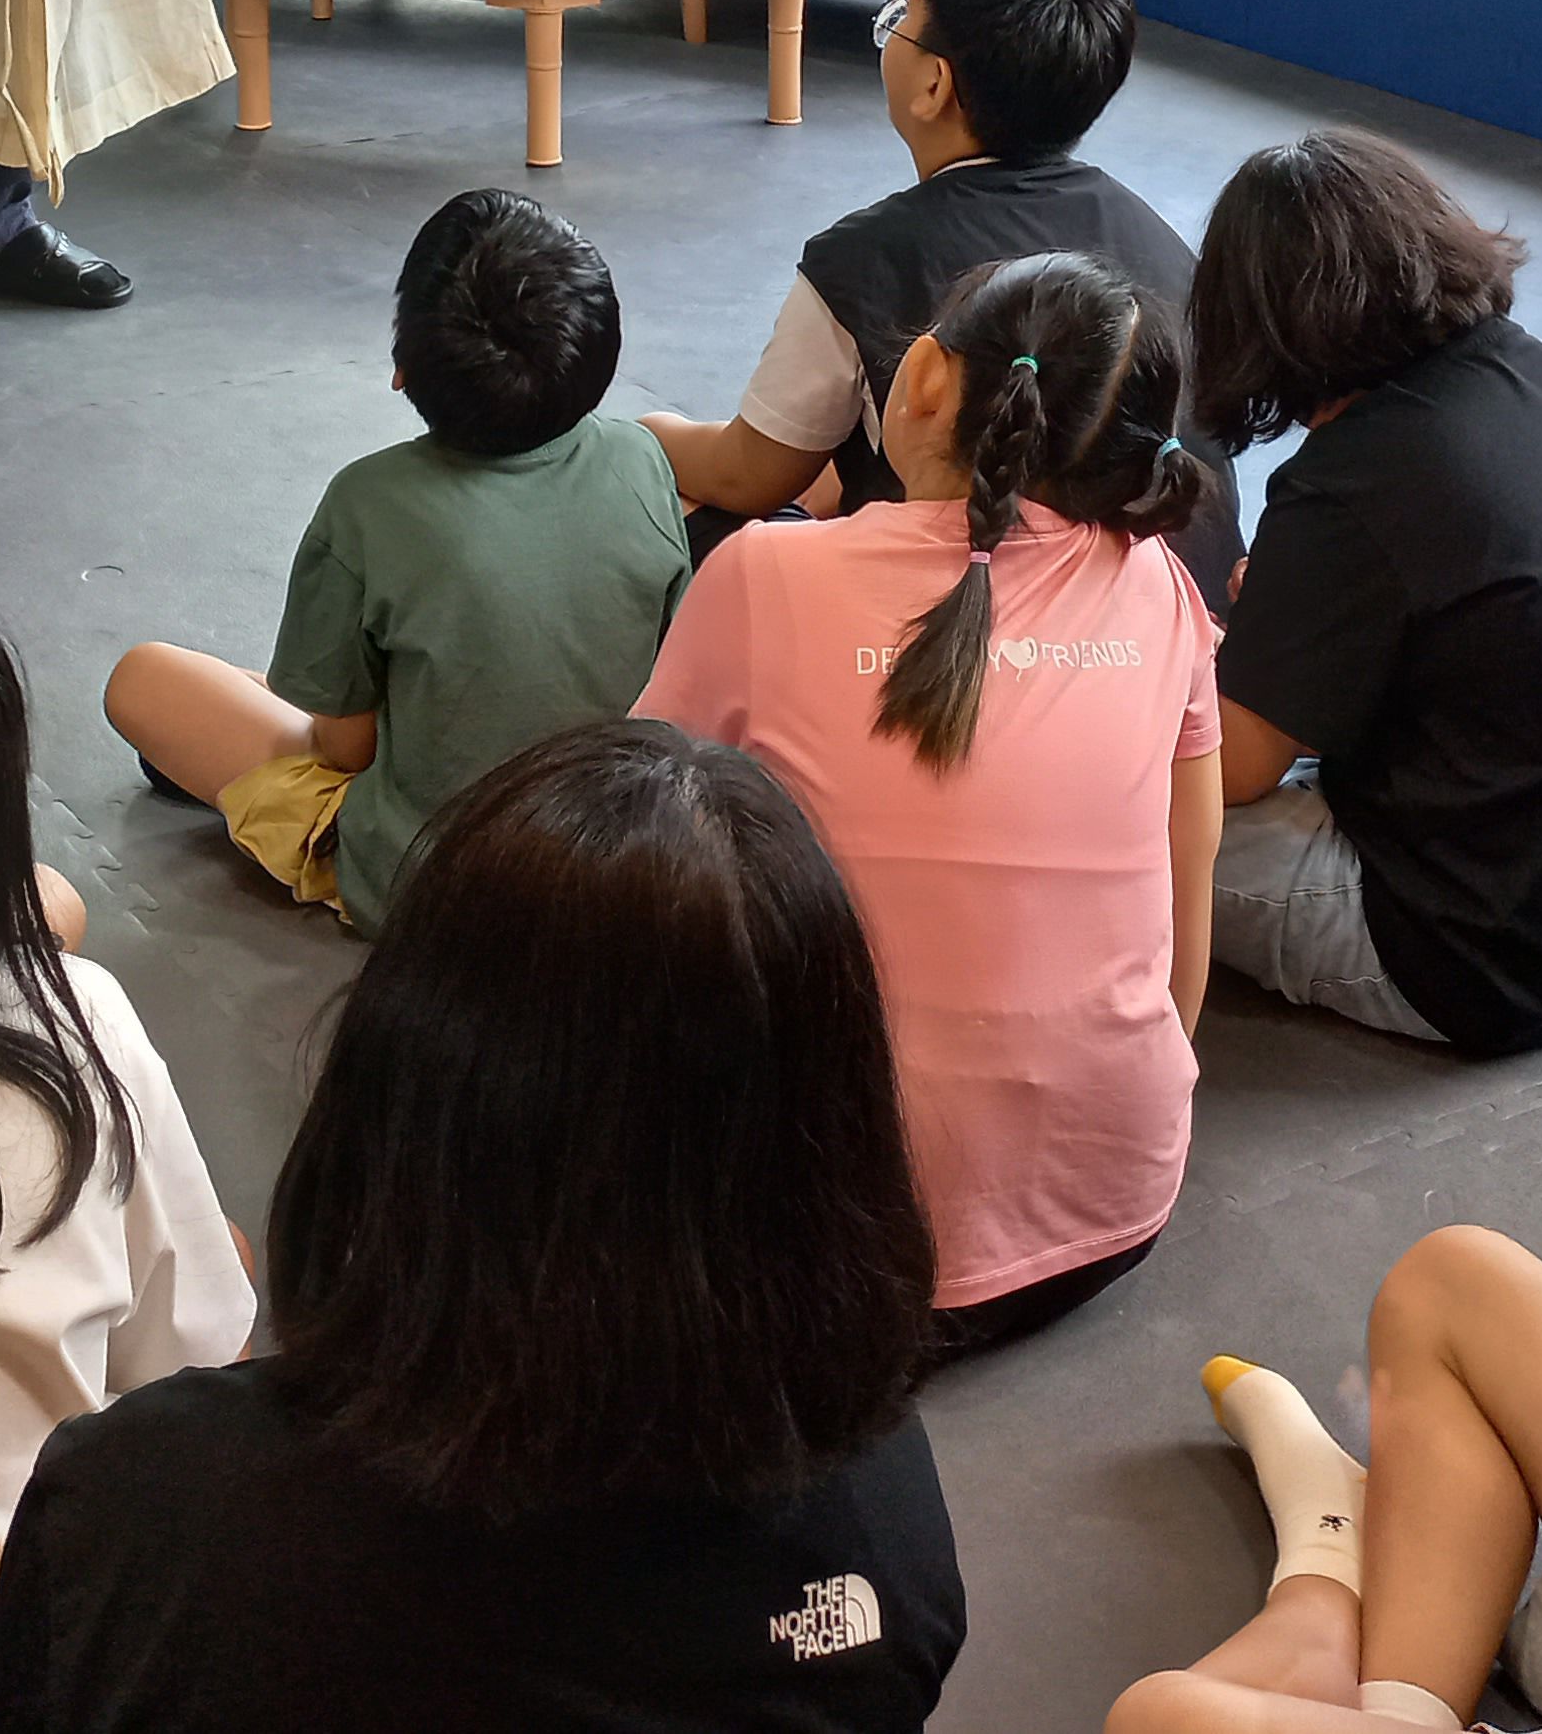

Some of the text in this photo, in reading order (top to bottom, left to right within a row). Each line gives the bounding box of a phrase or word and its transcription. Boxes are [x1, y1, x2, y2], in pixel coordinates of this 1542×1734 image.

[1042, 639, 1142, 669] FRIENDS
[802, 1575, 845, 1609] THE
[768, 1600, 845, 1644] NORTH
[793, 1626, 847, 1662] FACE
